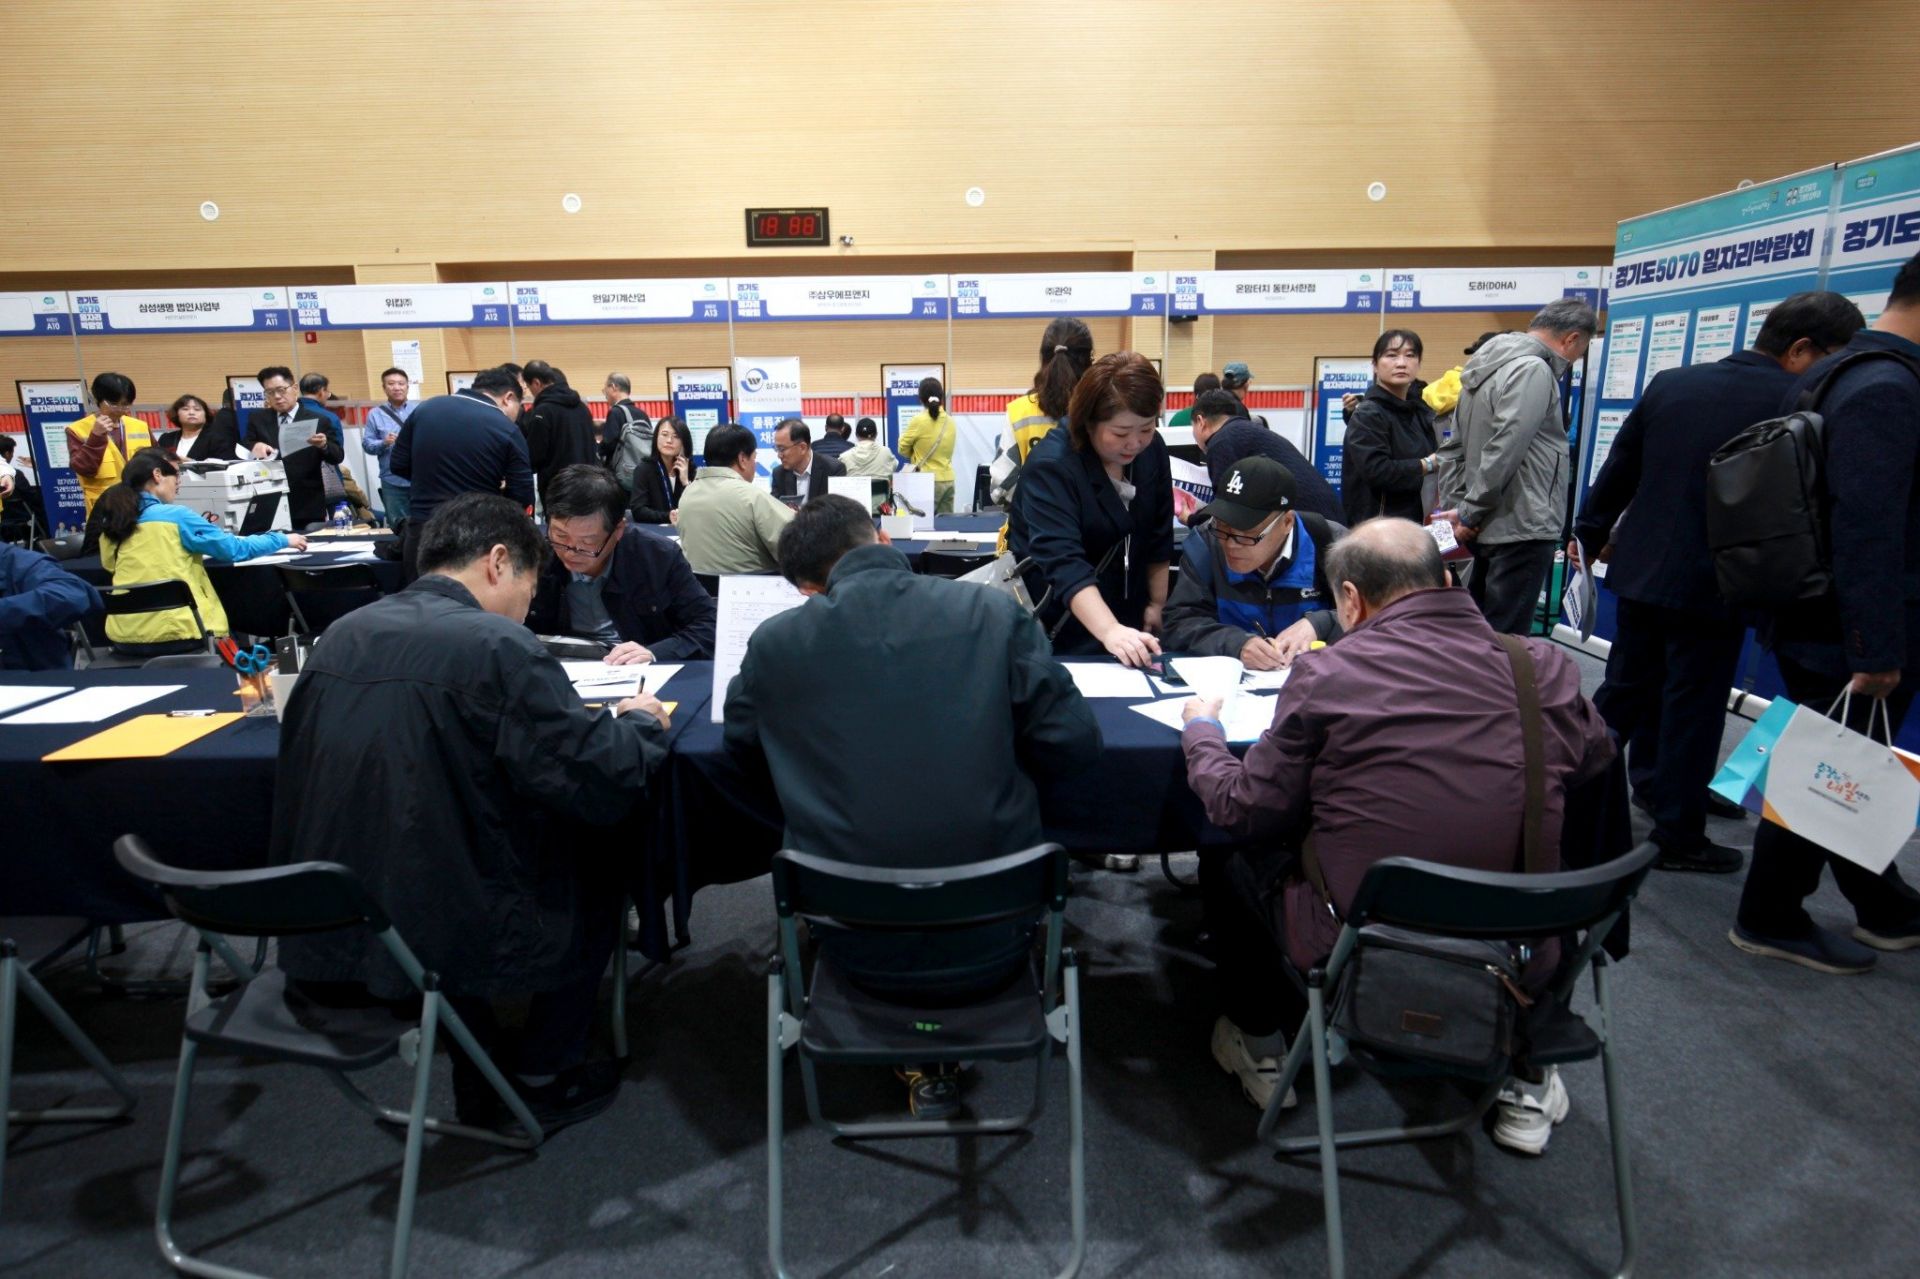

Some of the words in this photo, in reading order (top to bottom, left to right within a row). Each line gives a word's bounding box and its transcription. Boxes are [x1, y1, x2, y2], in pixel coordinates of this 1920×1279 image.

[1614, 250, 1701, 289] 경기도5070
[1702, 228, 1815, 275] 일자리박람회
[1393, 274, 1414, 282] 경기도
[957, 280, 979, 288] 경기도
[1392, 283, 1414, 291] 5070
[1468, 281, 1517, 291] 도하(DOHA)
[1175, 285, 1197, 293] 5070
[296, 292, 318, 300] 경기도
[592, 293, 646, 303] 원일기계산업
[737, 292, 759, 300] 5070
[957, 290, 979, 298] 5070
[77, 296, 100, 305] 경기도
[517, 296, 539, 304] 5070
[1357, 299, 1371, 308] A16
[79, 305, 101, 313] 5070
[139, 302, 174, 313] 삼성생명
[176, 301, 221, 312] 법인사업부
[297, 301, 319, 309] 5070
[1141, 303, 1155, 311] A15
[704, 308, 718, 318] A13
[922, 305, 937, 315] A14
[484, 312, 498, 321] A12
[46, 322, 60, 331] A10
[265, 318, 278, 327] A11
[677, 383, 722, 392] 경기도5070
[29, 396, 79, 405] 경기도5070
[760, 431, 776, 444] 채
[1226, 470, 1243, 495] LA
